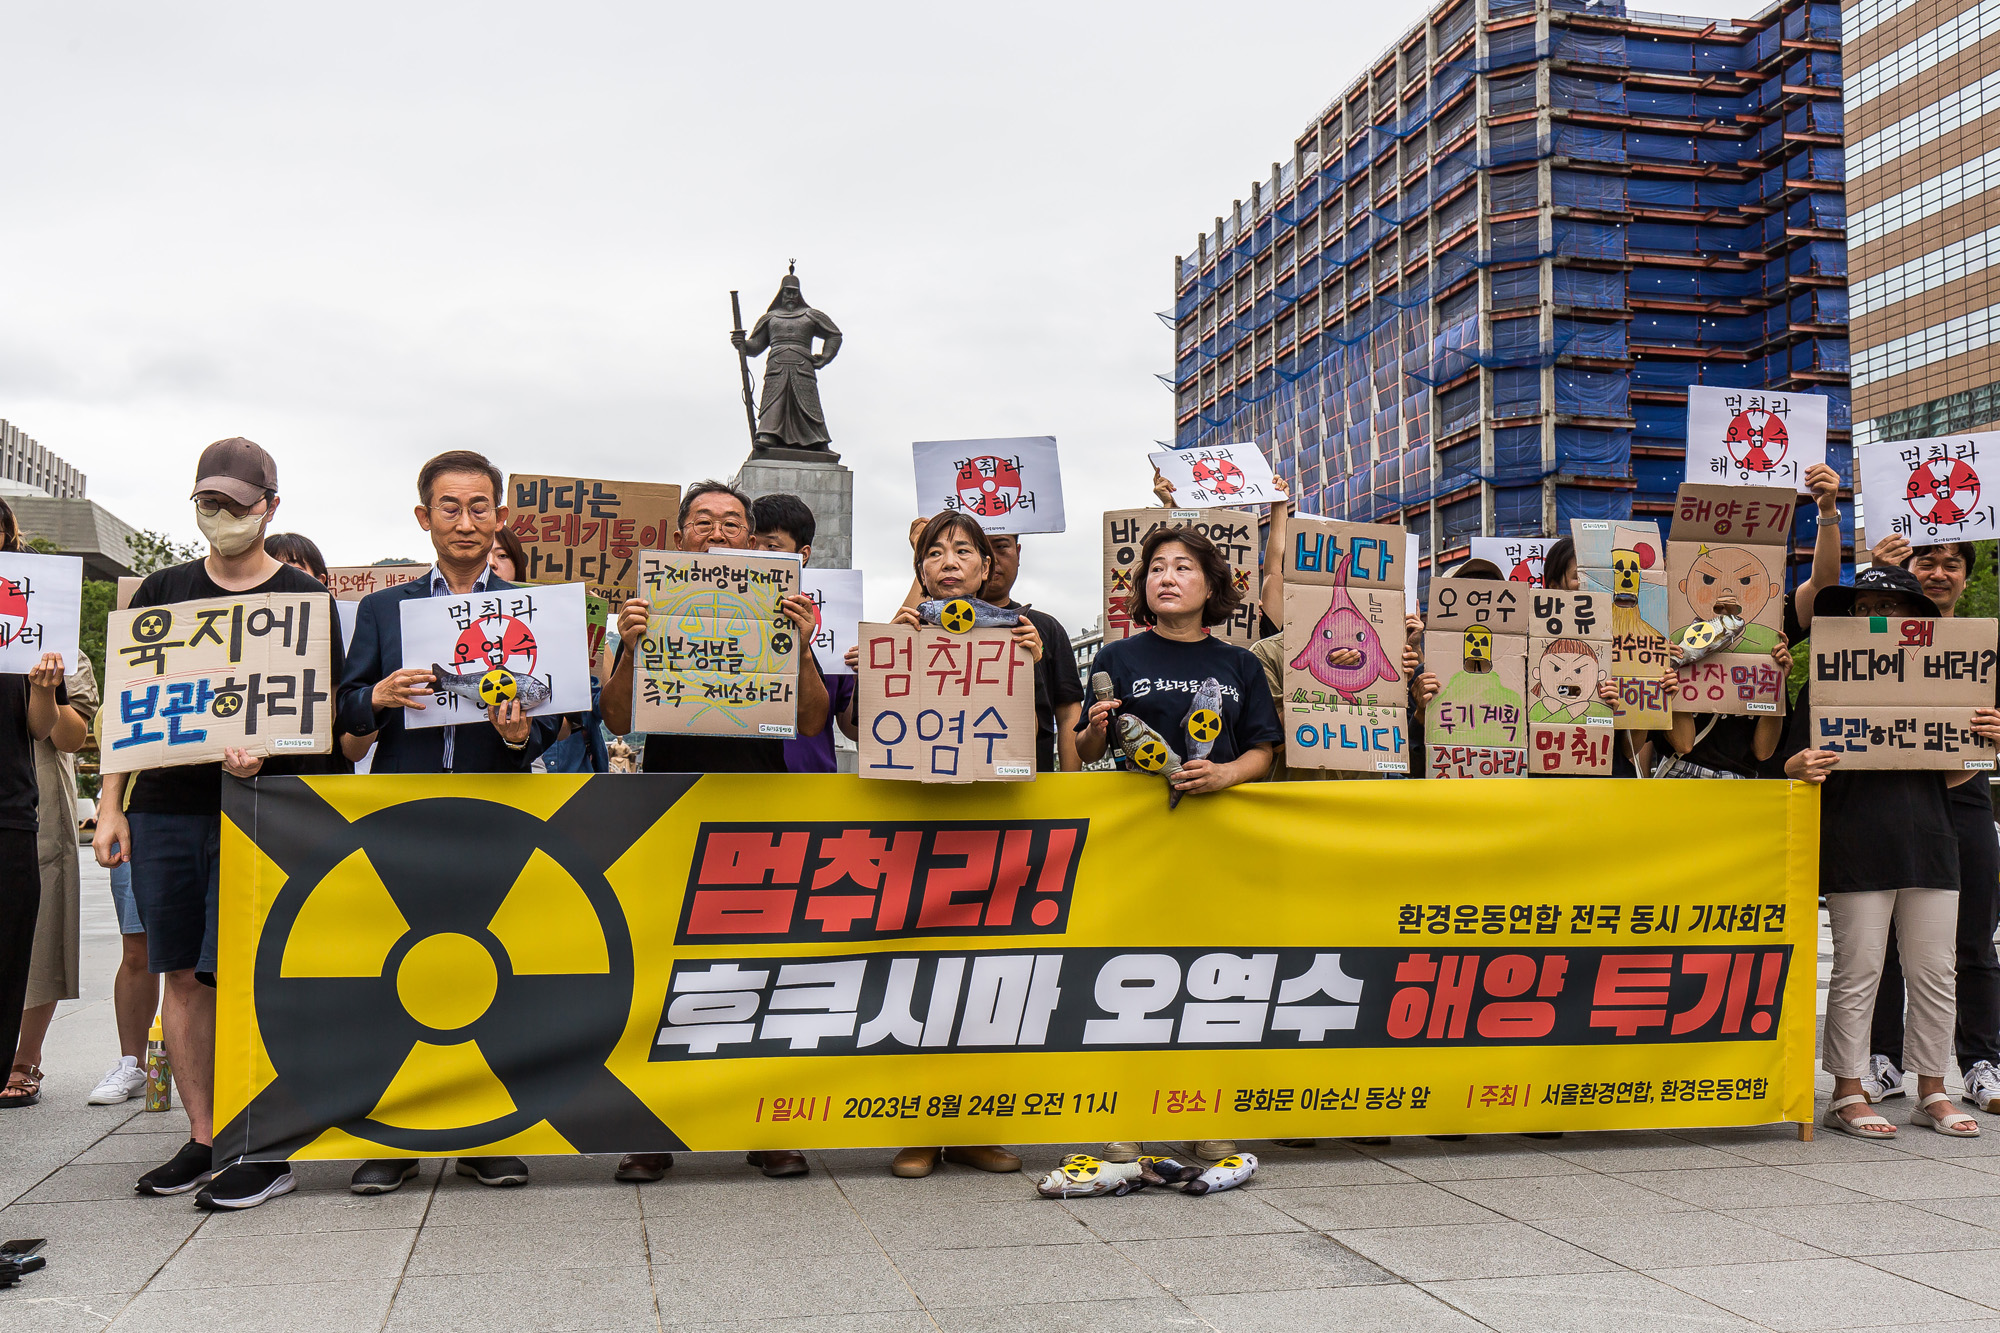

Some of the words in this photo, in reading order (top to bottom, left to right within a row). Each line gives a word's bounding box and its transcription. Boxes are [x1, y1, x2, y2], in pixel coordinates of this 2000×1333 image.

[1724, 394, 1791, 418] 멈춰라
[1722, 426, 1790, 448] 오염수
[953, 455, 1024, 480] 멈춰라
[1709, 456, 1798, 482] 해양투기
[1899, 440, 1980, 471] 멈춰라
[516, 478, 622, 519] 바다는
[1901, 473, 1981, 501] 오염수
[1680, 496, 1791, 537] 해양투기
[510, 513, 668, 559] 쓰레기통이
[1295, 532, 1394, 581] 바다
[448, 595, 537, 630] 멈춰라
[1436, 588, 1517, 623] 오염수
[1534, 595, 1596, 635] 방류
[119, 602, 311, 675] 육지에
[448, 634, 537, 667] 오염수
[1899, 620, 1934, 647] 왜
[640, 636, 745, 675] 일본정부를
[1817, 648, 1904, 682] 바다에
[1923, 649, 1997, 684] 버려?
[112, 669, 328, 751] 보관하라
[642, 678, 685, 708] 즉각
[702, 681, 793, 704] 제소하라
[1295, 722, 1406, 754] 아니다
[1439, 702, 1475, 735] 투기
[1479, 703, 1520, 743] 계획
[1819, 717, 1917, 753] 보관하면
[870, 706, 1008, 776] 오염수
[1536, 727, 1610, 771] 멈춰!
[1432, 746, 1528, 779] 중단하라
[687, 828, 1078, 935] 멈춰라!
[1398, 904, 1561, 935] 환경운동연합
[1570, 904, 1620, 934] 전국
[1630, 904, 1680, 934] 동시
[1688, 904, 1787, 934] 기자회견
[657, 954, 1064, 1054] 후쿠시마
[1083, 952, 1364, 1046] 오염수
[1386, 952, 1569, 1040] 해양
[1590, 952, 1782, 1037] 투기!
[843, 1095, 921, 1120] 2023년
[926, 1094, 961, 1119] 8월
[968, 1093, 1015, 1118] 24일
[1022, 1092, 1065, 1117] 오전
[1072, 1091, 1117, 1116] 11시
[1233, 1087, 1294, 1112] 광화문
[1299, 1087, 1360, 1112] 이순신
[1365, 1086, 1406, 1110] 동상
[1410, 1085, 1431, 1110] 앞
[1540, 1081, 1655, 1106] 서울환경연합,
[1659, 1078, 1769, 1104] 환경운동연합
